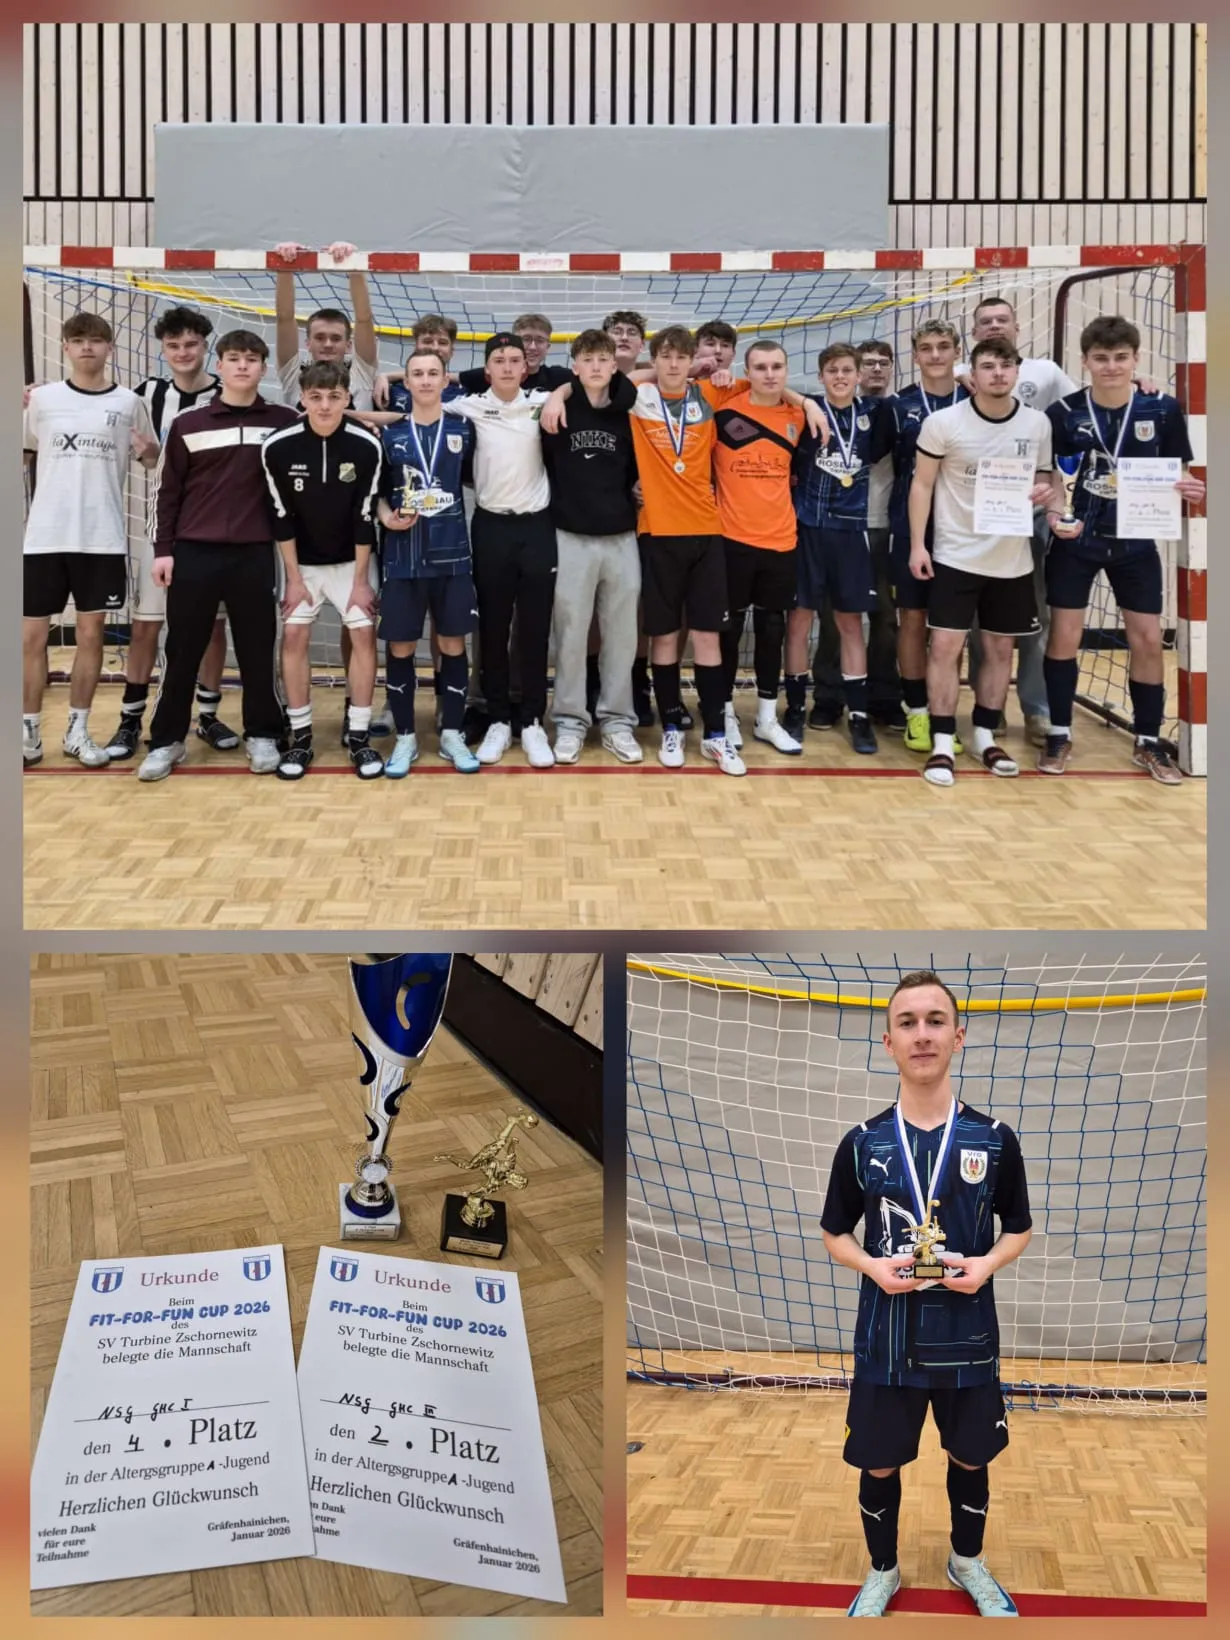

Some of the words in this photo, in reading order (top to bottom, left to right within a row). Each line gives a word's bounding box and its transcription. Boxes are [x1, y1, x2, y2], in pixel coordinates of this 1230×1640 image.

[571, 431, 616, 451] NIKE
[294, 477, 304, 491] 8
[140, 1268, 219, 1287] Urkunde
[374, 1270, 452, 1293] Urkunde
[169, 1297, 195, 1307] Beim
[402, 1300, 428, 1312] Beim
[89, 1308, 194, 1327] FIT-FOR-FUN
[199, 1305, 229, 1319] CUP
[234, 1301, 271, 1316] 2026
[329, 1300, 428, 1326] FIT-FOR-FUN
[433, 1315, 463, 1330] CUP
[468, 1321, 507, 1338] 2026
[171, 1320, 189, 1330] des
[406, 1324, 424, 1334] des
[97, 1337, 117, 1349] SV
[120, 1334, 172, 1348] Turbine
[175, 1327, 257, 1343] Zschornewitz
[337, 1324, 356, 1337] SV
[358, 1328, 407, 1345] Turbine
[411, 1336, 495, 1359] Zschornewitz
[102, 1351, 150, 1365] belegte
[154, 1348, 174, 1360] die
[179, 1341, 252, 1358] Mannschaft
[343, 1340, 387, 1357] belegte
[391, 1348, 411, 1360] die
[415, 1352, 490, 1373] Mannschaft
[83, 1443, 111, 1456] den
[126, 1434, 142, 1452] 4
[189, 1418, 257, 1445] Platz
[329, 1423, 356, 1440] den
[369, 1425, 389, 1444] 2
[430, 1427, 500, 1464] Platz
[65, 1472, 79, 1486] in
[84, 1470, 107, 1484] der
[218, 1452, 270, 1472] -Jugend
[314, 1448, 327, 1462] in
[331, 1452, 353, 1468] der
[461, 1474, 515, 1495] -Jugend
[58, 1496, 146, 1518] Herzlichen
[152, 1481, 259, 1508] Glückwunsch
[311, 1475, 392, 1504] Herzlichen
[397, 1491, 505, 1525] Glückwunsch
[321, 1502, 346, 1515] Dank
[207, 1514, 290, 1532] Gräfenhainichen,
[315, 1514, 336, 1525] eure
[37, 1525, 68, 1539] vielen
[70, 1523, 97, 1534] Dank
[230, 1530, 265, 1542] Januar
[267, 1526, 291, 1538] 2026
[44, 1539, 60, 1550] für
[62, 1538, 86, 1548] eure
[453, 1537, 539, 1562] Gräfenhainichen,
[36, 1549, 90, 1563] Teilnahme
[478, 1554, 513, 1569] Januar
[515, 1561, 541, 1574] 2026
